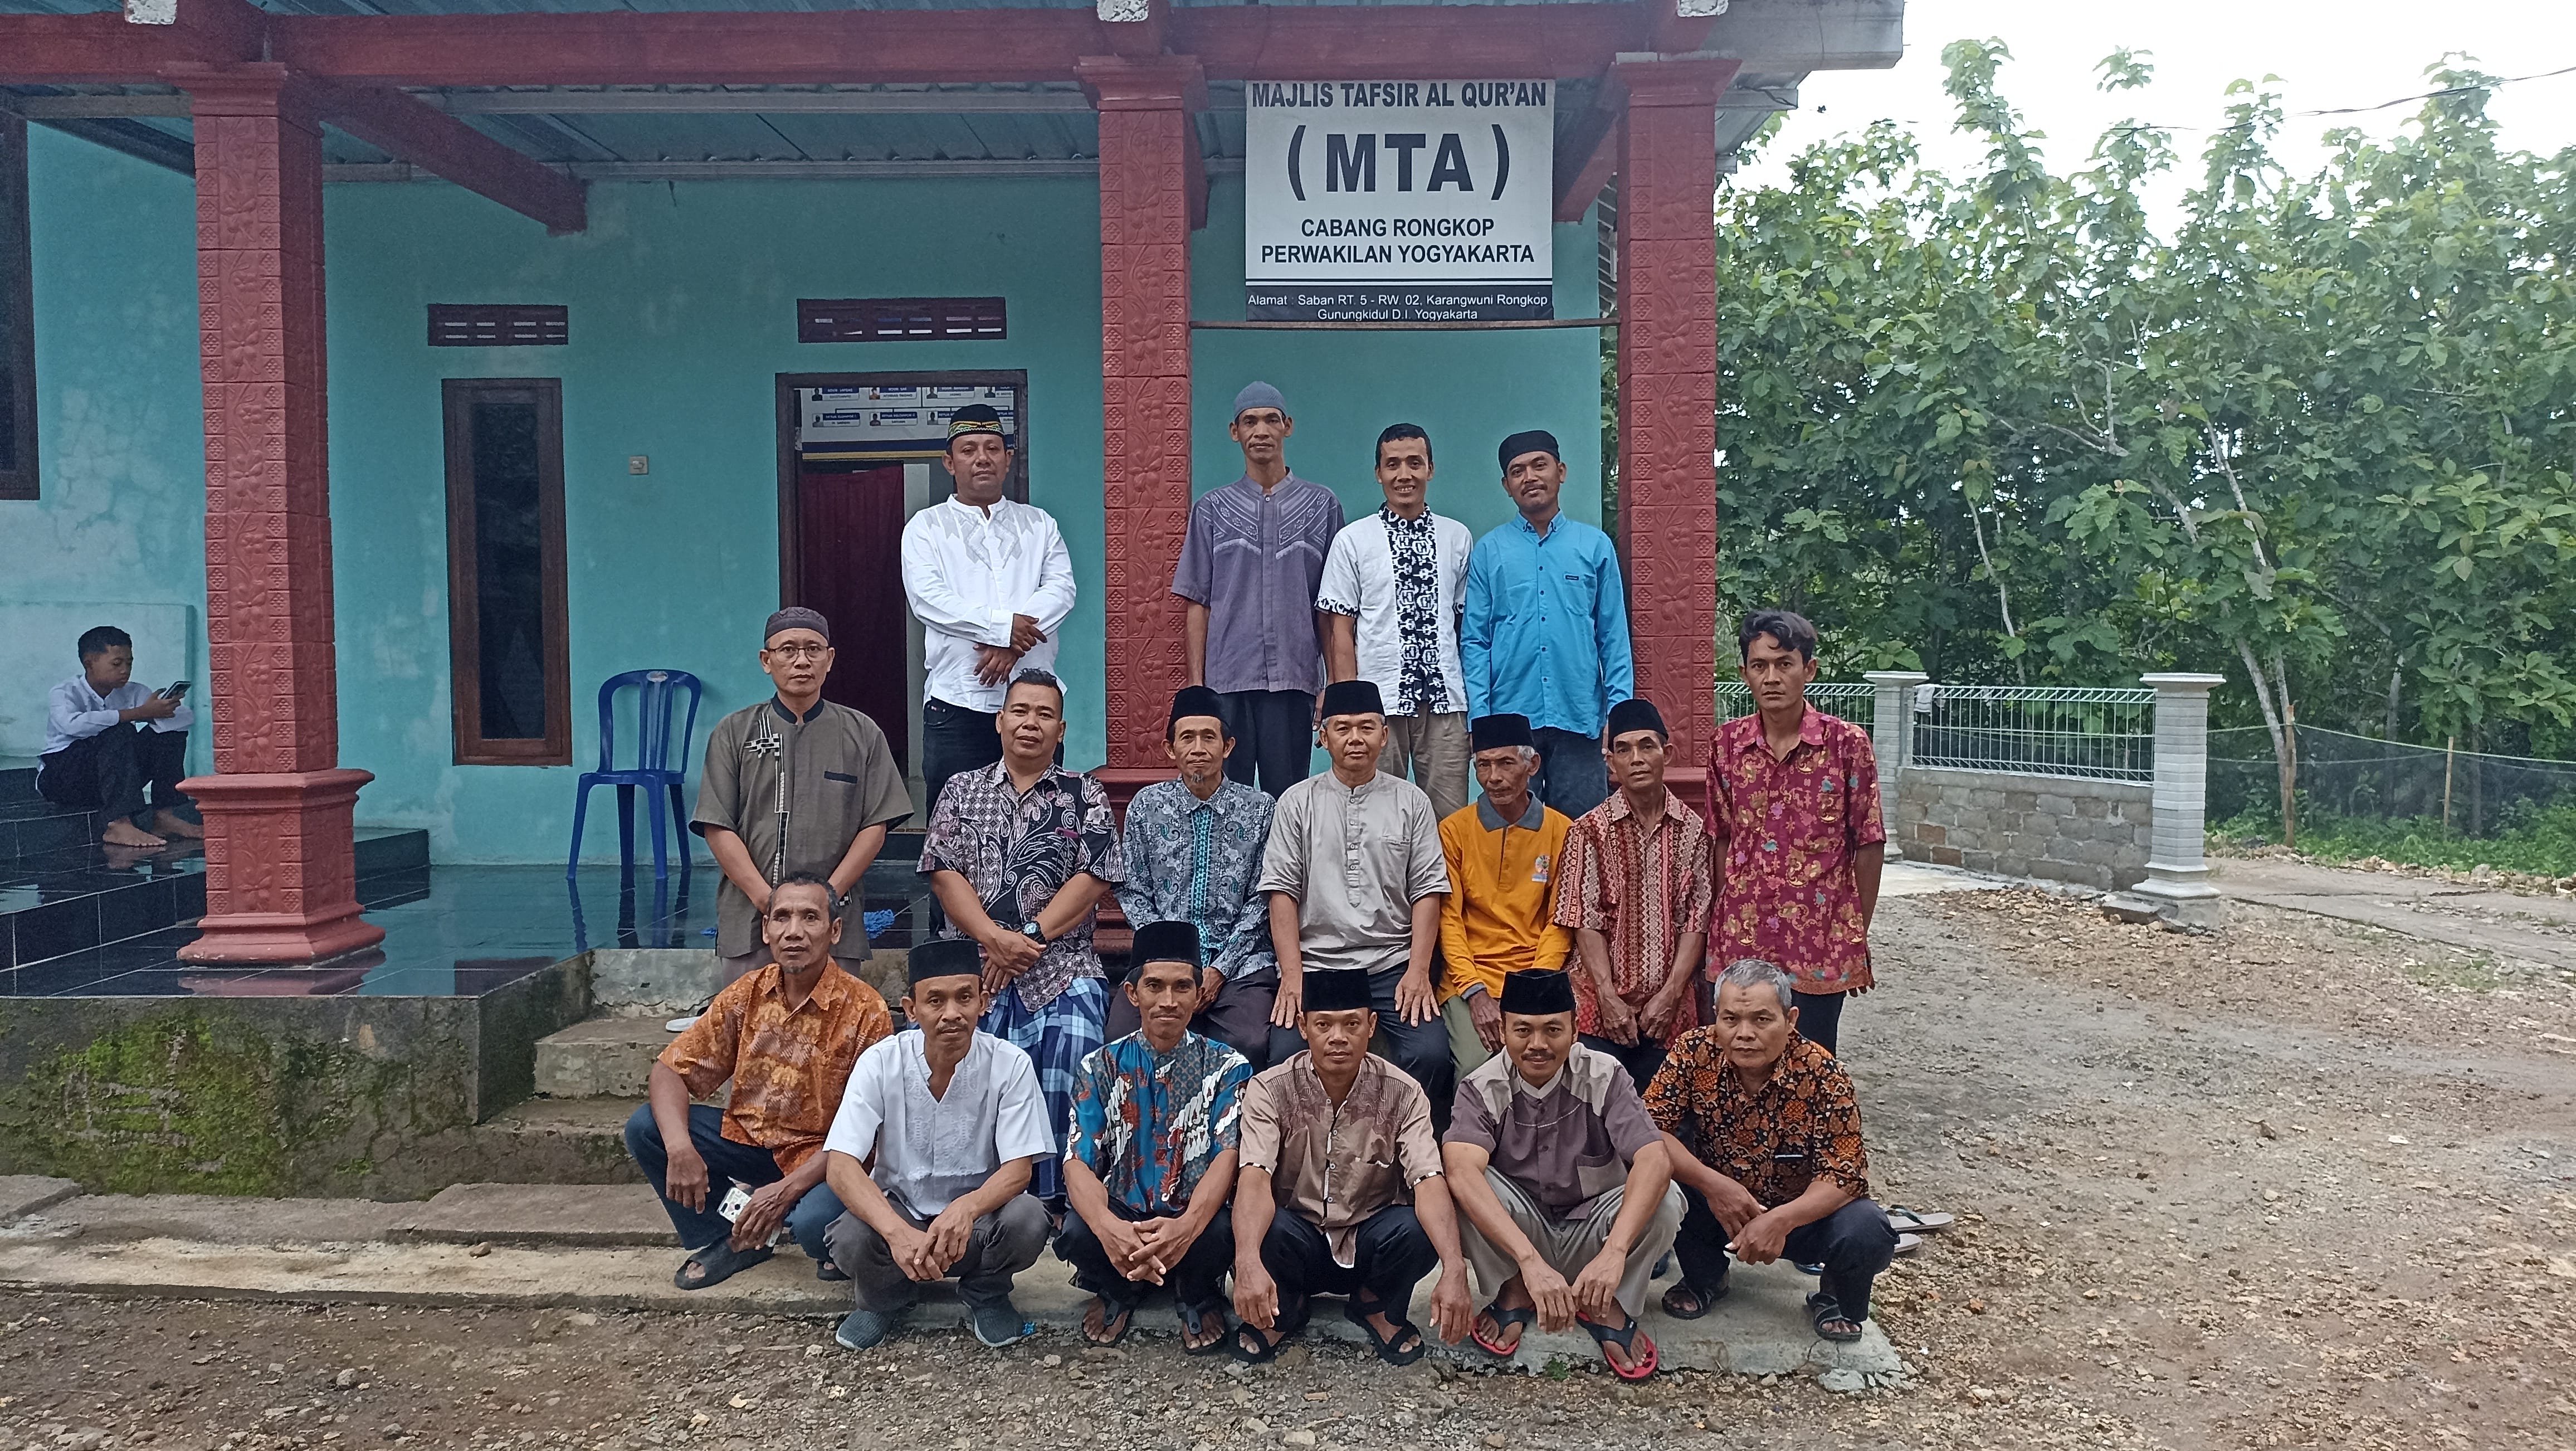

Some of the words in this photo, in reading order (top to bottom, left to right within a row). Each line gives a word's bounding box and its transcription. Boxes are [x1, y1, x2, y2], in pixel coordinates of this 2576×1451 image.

[1252, 82, 1334, 107] MAJLIS
[1340, 82, 1419, 107] TAFSIR
[1425, 82, 1455, 106] AL
[1301, 218, 1387, 237] CABANG
[1393, 218, 1494, 237] RONGKOP
[1262, 245, 1392, 263] PERWAKILAN
[1397, 245, 1535, 263] YOGYAKARTA
[1248, 294, 1287, 305] Alamat
[1298, 294, 1334, 305] Saban
[1360, 295, 1367, 305] 5
[1427, 294, 1493, 308] Karangwuni
[1497, 294, 1548, 308] Rongkop
[1318, 308, 1388, 322] Gunungkidul
[1414, 309, 1477, 321] Yogyakarta
